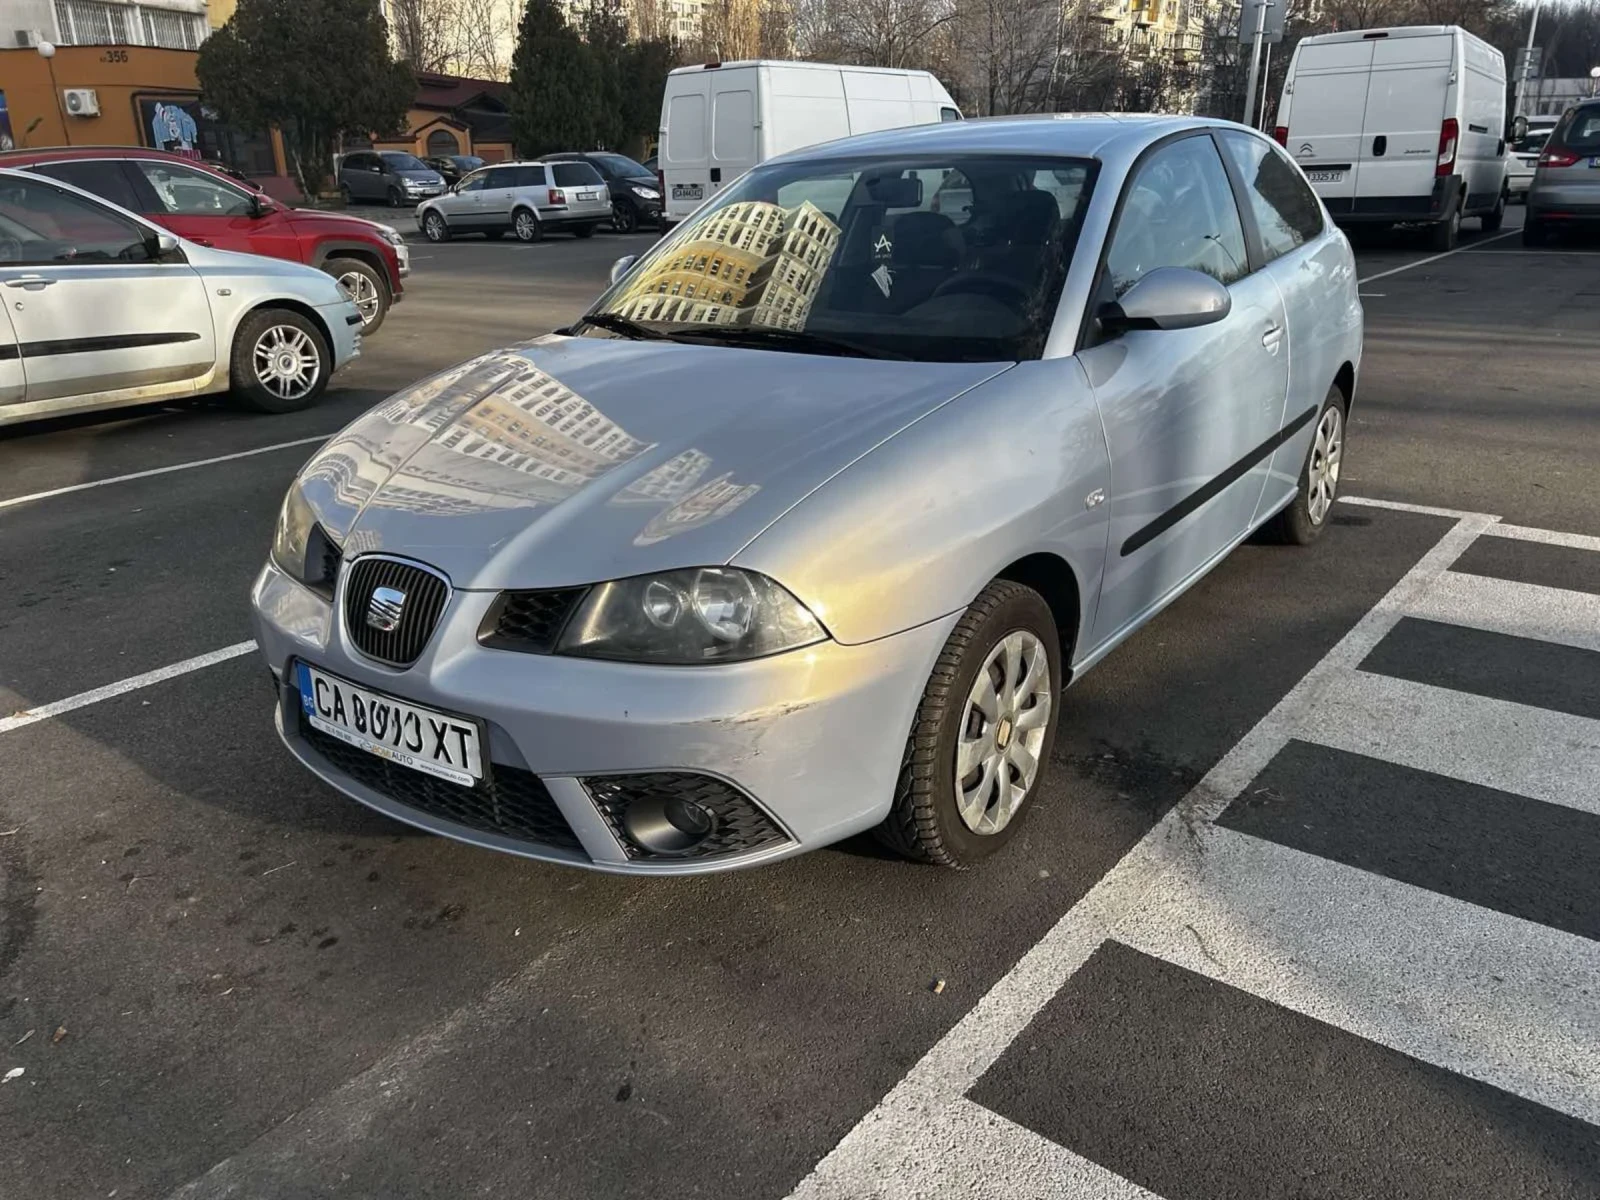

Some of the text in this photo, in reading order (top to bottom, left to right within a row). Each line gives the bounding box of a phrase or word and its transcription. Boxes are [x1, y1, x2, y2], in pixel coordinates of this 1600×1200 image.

[106, 50, 128, 63] 356
[303, 694, 314, 708] BG
[315, 677, 348, 727] CA
[429, 718, 473, 769] XT
